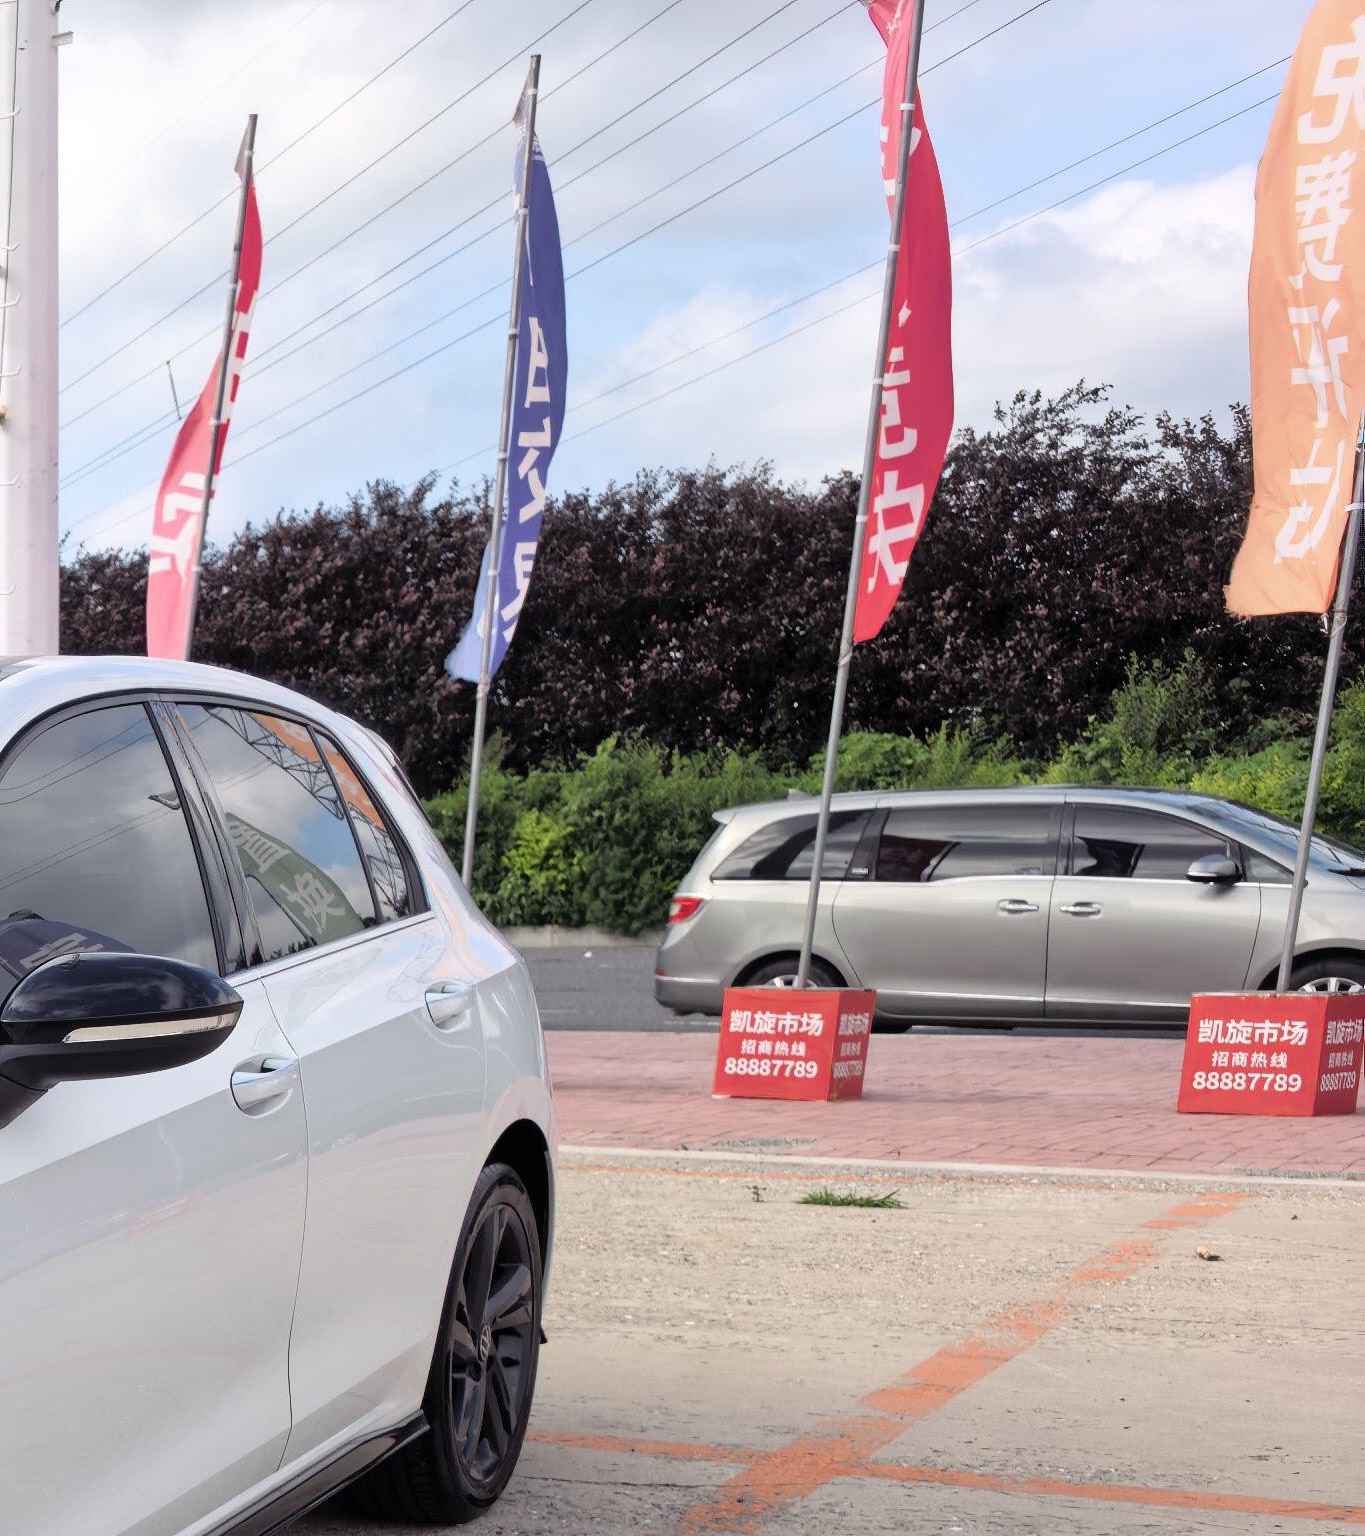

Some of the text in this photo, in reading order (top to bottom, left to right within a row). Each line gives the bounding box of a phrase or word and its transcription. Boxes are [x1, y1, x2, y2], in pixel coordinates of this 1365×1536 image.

[729, 1009, 824, 1036] 凯旋市场
[1197, 1018, 1308, 1046] 凯旋市场
[1325, 1019, 1364, 1045] 凯旋市场
[740, 1039, 806, 1056] 招商热线
[724, 1057, 818, 1079] 88887789
[1211, 1050, 1288, 1068] 招商热线
[1192, 1071, 1302, 1093] 88887789
[1320, 1071, 1356, 1093] 88887789
